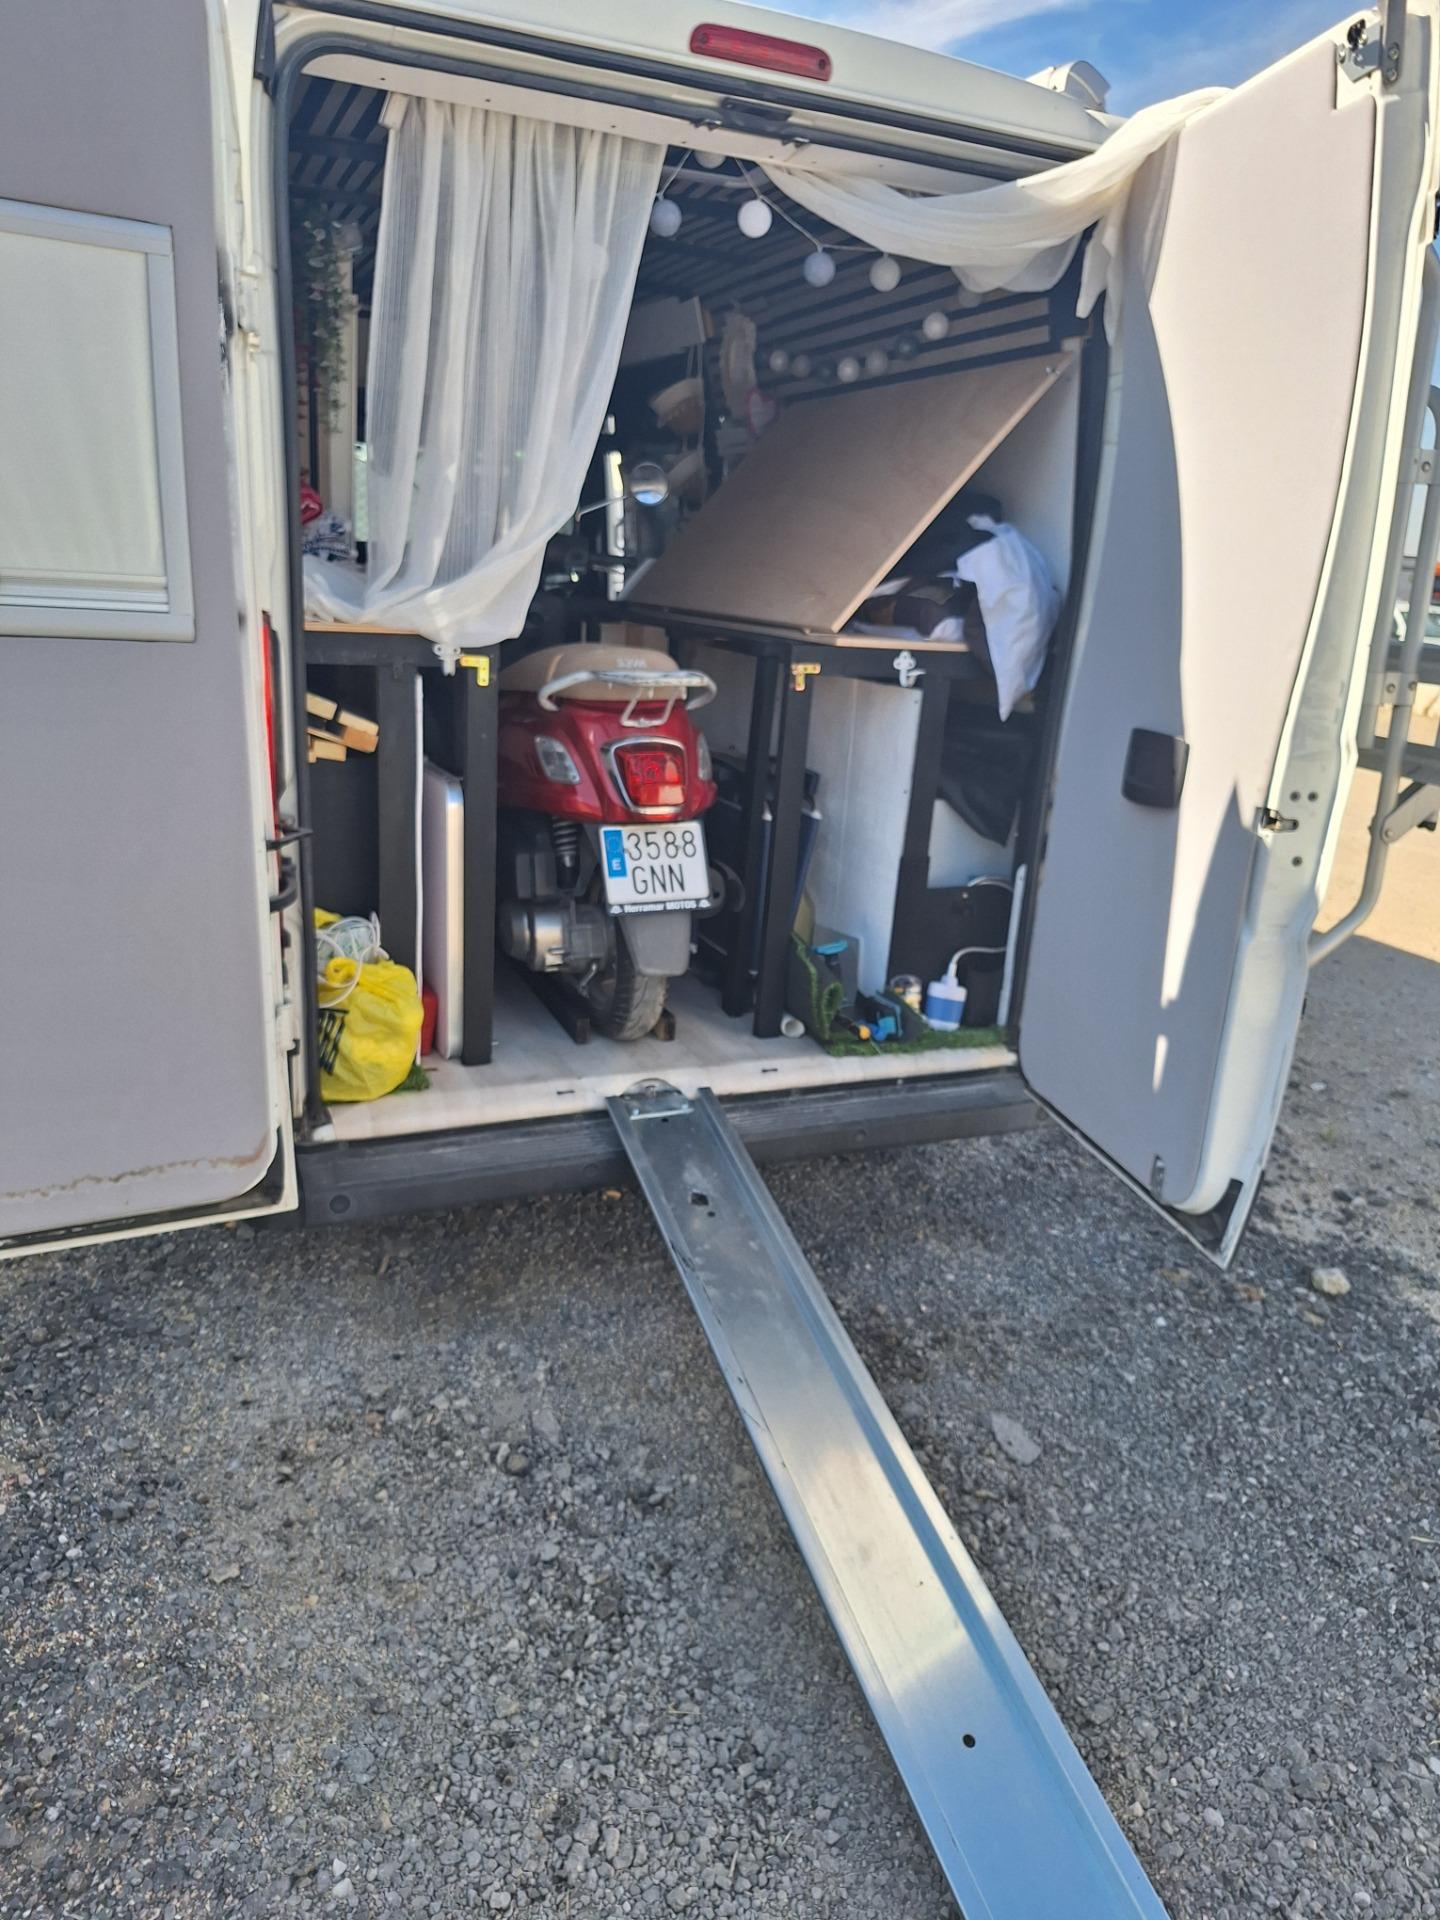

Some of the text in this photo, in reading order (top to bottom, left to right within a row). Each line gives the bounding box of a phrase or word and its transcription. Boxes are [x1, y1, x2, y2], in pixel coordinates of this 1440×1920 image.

[627, 830, 696, 861] 3588
[612, 858, 621, 871] E
[632, 864, 685, 894] GNN
[666, 900, 697, 910] MOTOS
